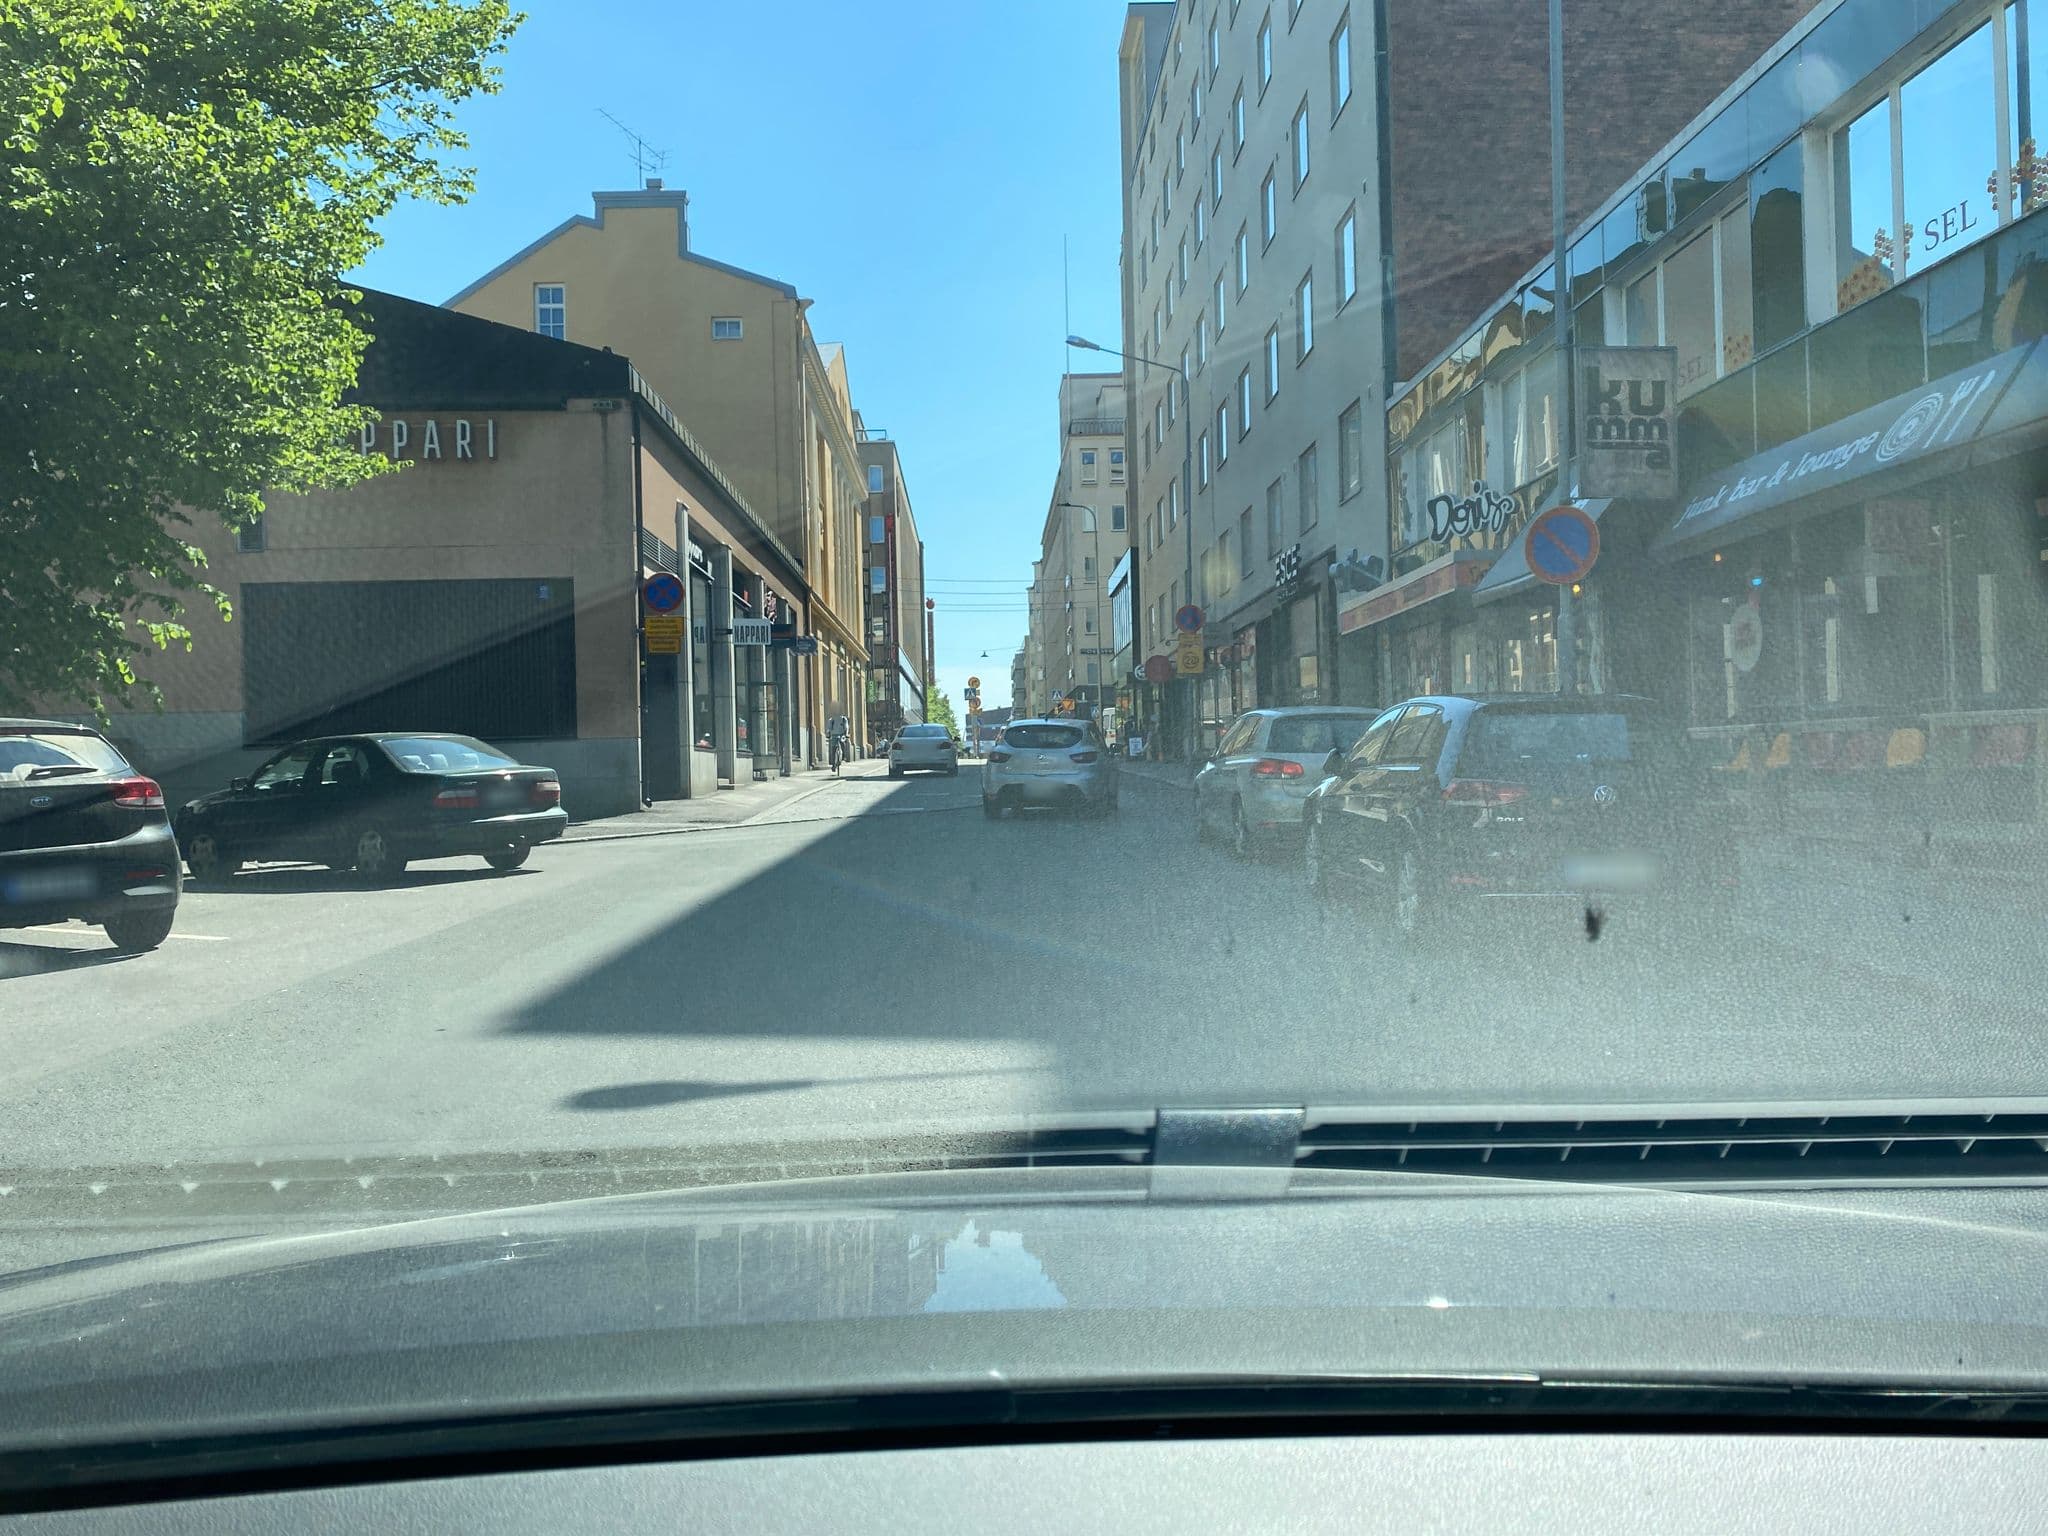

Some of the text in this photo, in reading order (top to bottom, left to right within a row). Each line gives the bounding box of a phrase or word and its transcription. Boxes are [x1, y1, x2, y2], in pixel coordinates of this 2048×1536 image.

[1924, 200, 1978, 251] SEL
[360, 419, 495, 459] PPARI
[1728, 476, 1768, 502] bar
[1766, 461, 1790, 488] &
[1788, 431, 1881, 480] lounge
